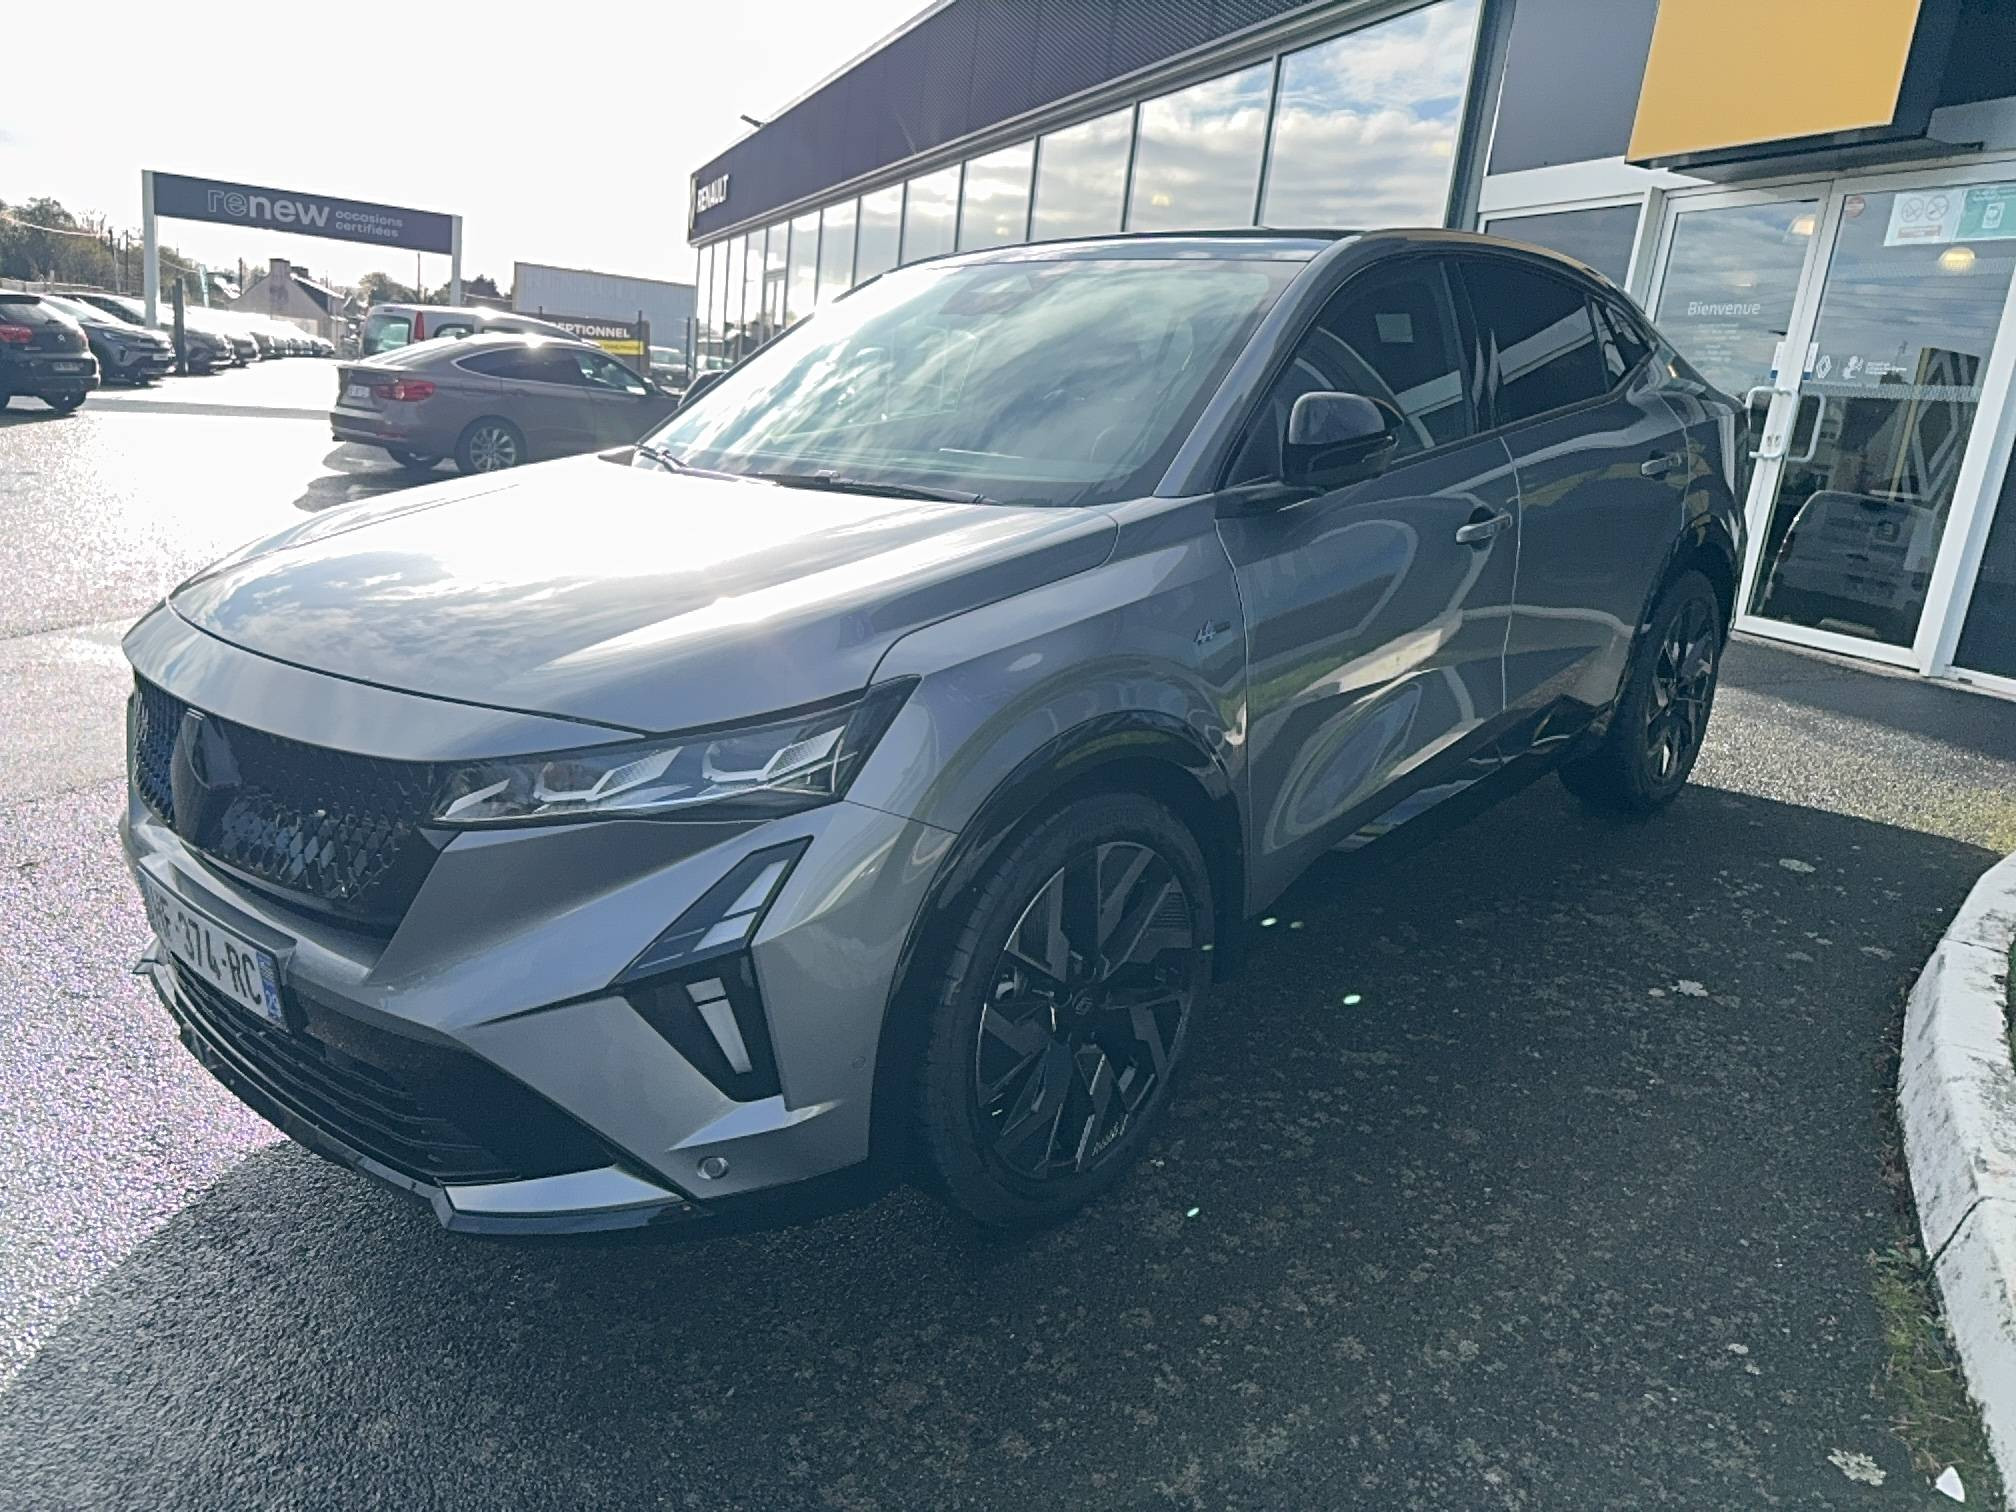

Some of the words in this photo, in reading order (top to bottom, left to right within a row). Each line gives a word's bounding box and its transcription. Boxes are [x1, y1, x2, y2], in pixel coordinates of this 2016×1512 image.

[207, 189, 331, 227] renew
[335, 210, 403, 228] occasions
[1687, 301, 1761, 316] Bienvenue
[556, 321, 631, 339] EPTIONNEL
